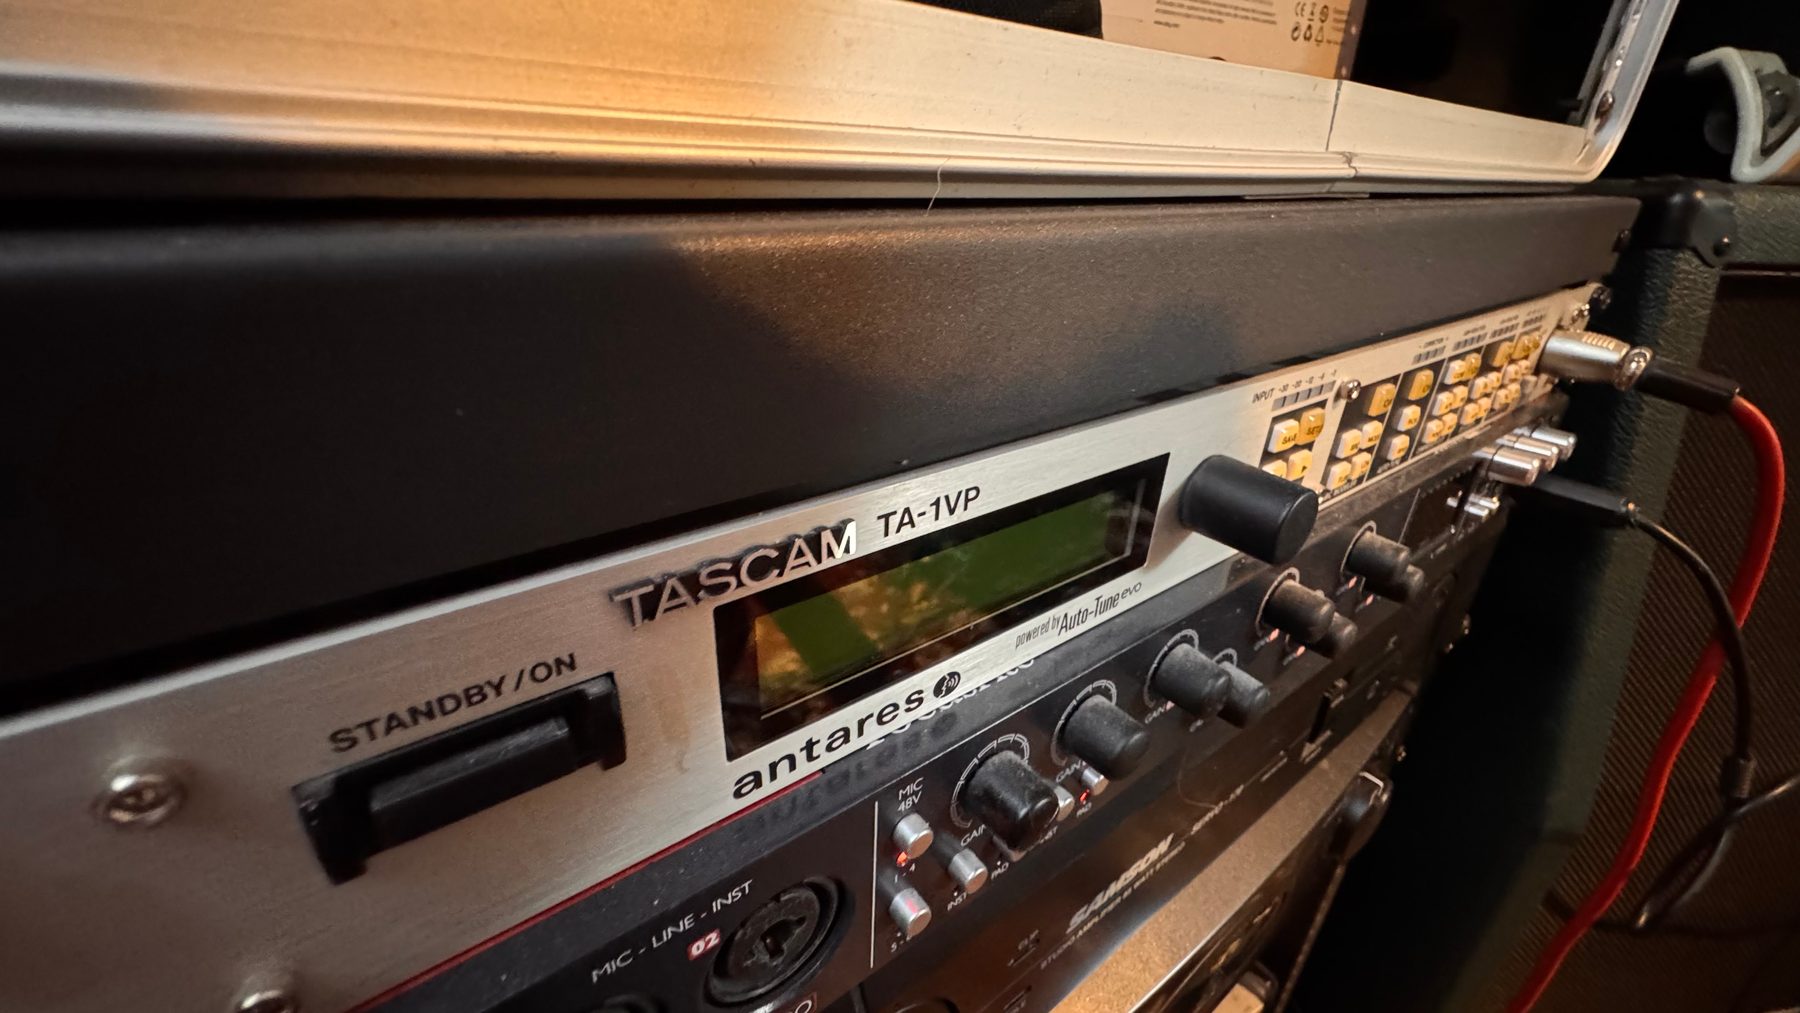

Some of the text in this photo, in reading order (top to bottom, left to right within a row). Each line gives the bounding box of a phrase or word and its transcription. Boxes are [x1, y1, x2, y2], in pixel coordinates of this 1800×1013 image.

[1252, 387, 1275, 403] INPUT
[610, 486, 980, 630] TASCAM TA-1VP
[1015, 582, 1142, 650] powered by Auto-Tune evo
[732, 687, 925, 800] antares
[897, 791, 922, 813] 48V
[898, 777, 924, 800] MIC
[947, 892, 967, 911] INST
[591, 949, 634, 983] MIC
[651, 913, 696, 948] LINE
[712, 879, 753, 913] INST
[690, 929, 721, 956] 02
